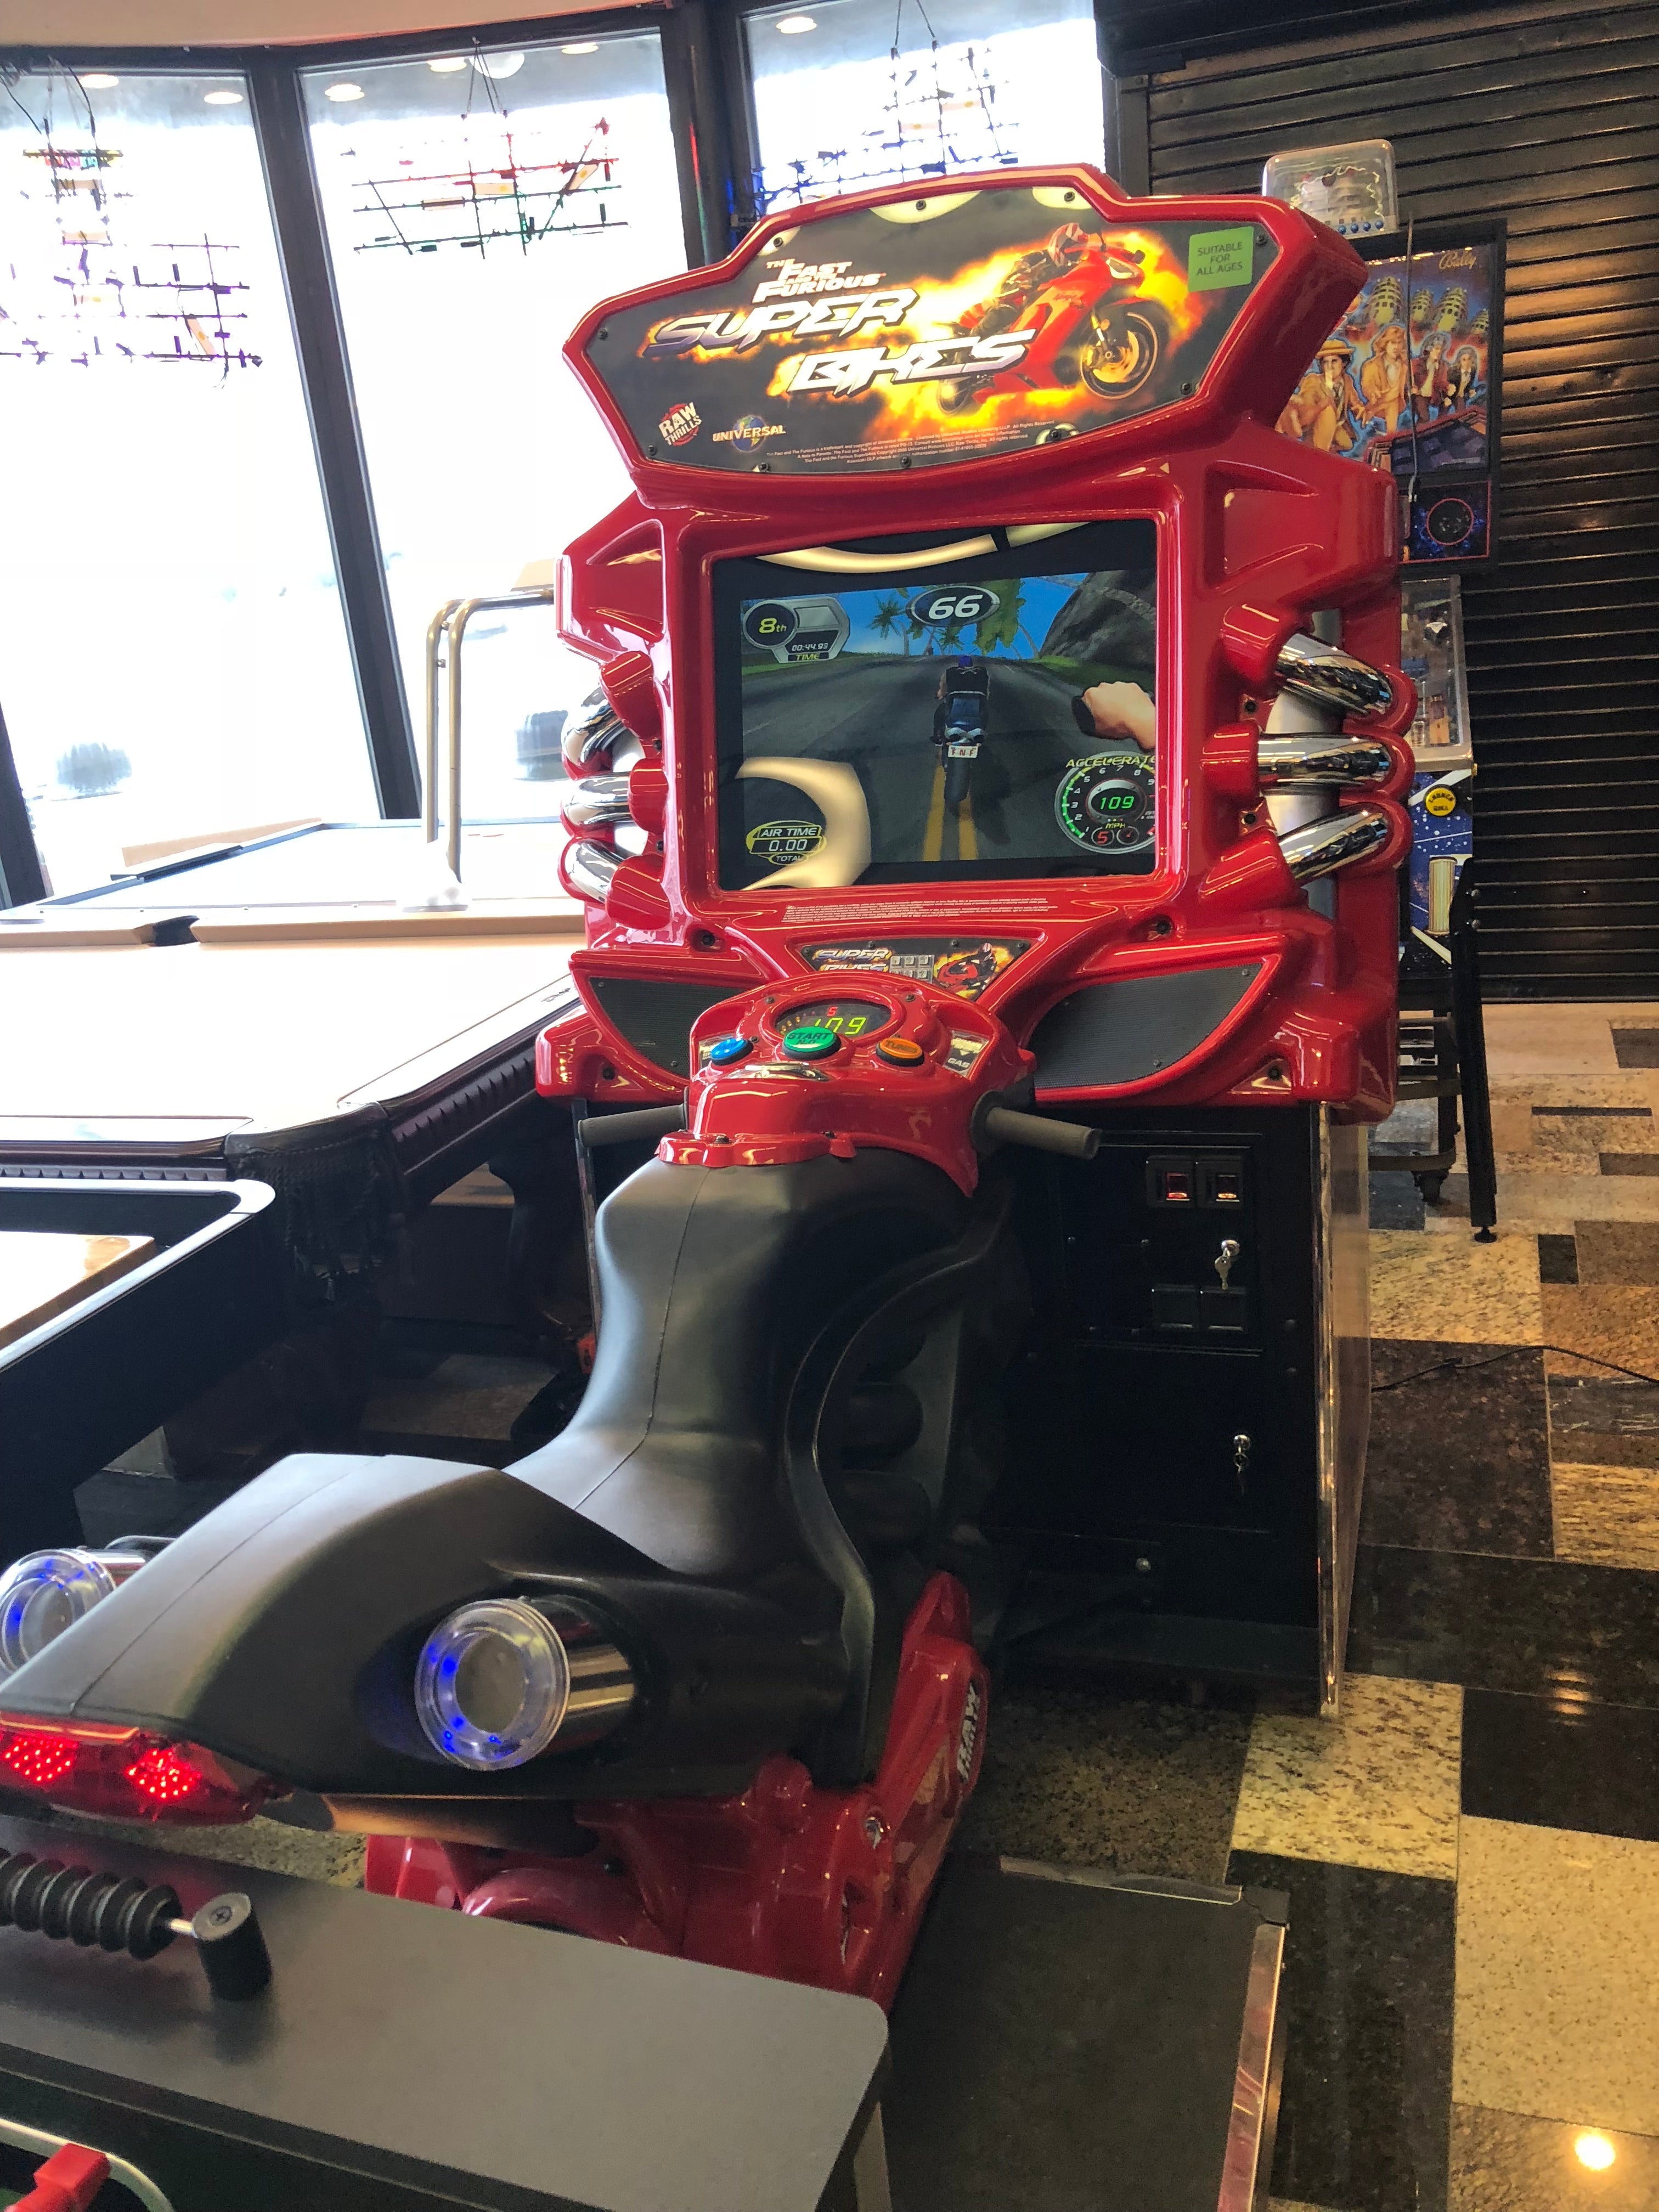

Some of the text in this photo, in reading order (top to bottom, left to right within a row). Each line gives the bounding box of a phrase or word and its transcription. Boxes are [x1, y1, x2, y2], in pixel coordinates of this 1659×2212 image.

[1198, 241, 1243, 256] SUITABLE
[766, 258, 795, 269] THE
[1210, 253, 1230, 264] FOR
[778, 262, 853, 281] FAST
[1197, 262, 1243, 276] ALL AGES
[752, 274, 882, 303] FURIOUS
[650, 289, 919, 352] SUPER
[787, 329, 1036, 396] BIKES
[658, 402, 697, 438] RAW
[664, 415, 702, 446] THRILLS
[713, 425, 786, 442] UNIVERSAL
[929, 595, 983, 619] 66
[759, 618, 787, 634] 8th
[1099, 796, 1135, 810] 109
[760, 827, 817, 837] AIR TIME
[1097, 831, 1109, 844] 5
[768, 839, 808, 851] 0.00
[817, 949, 889, 960] SUPER
[947, 1058, 970, 1068] GAS
